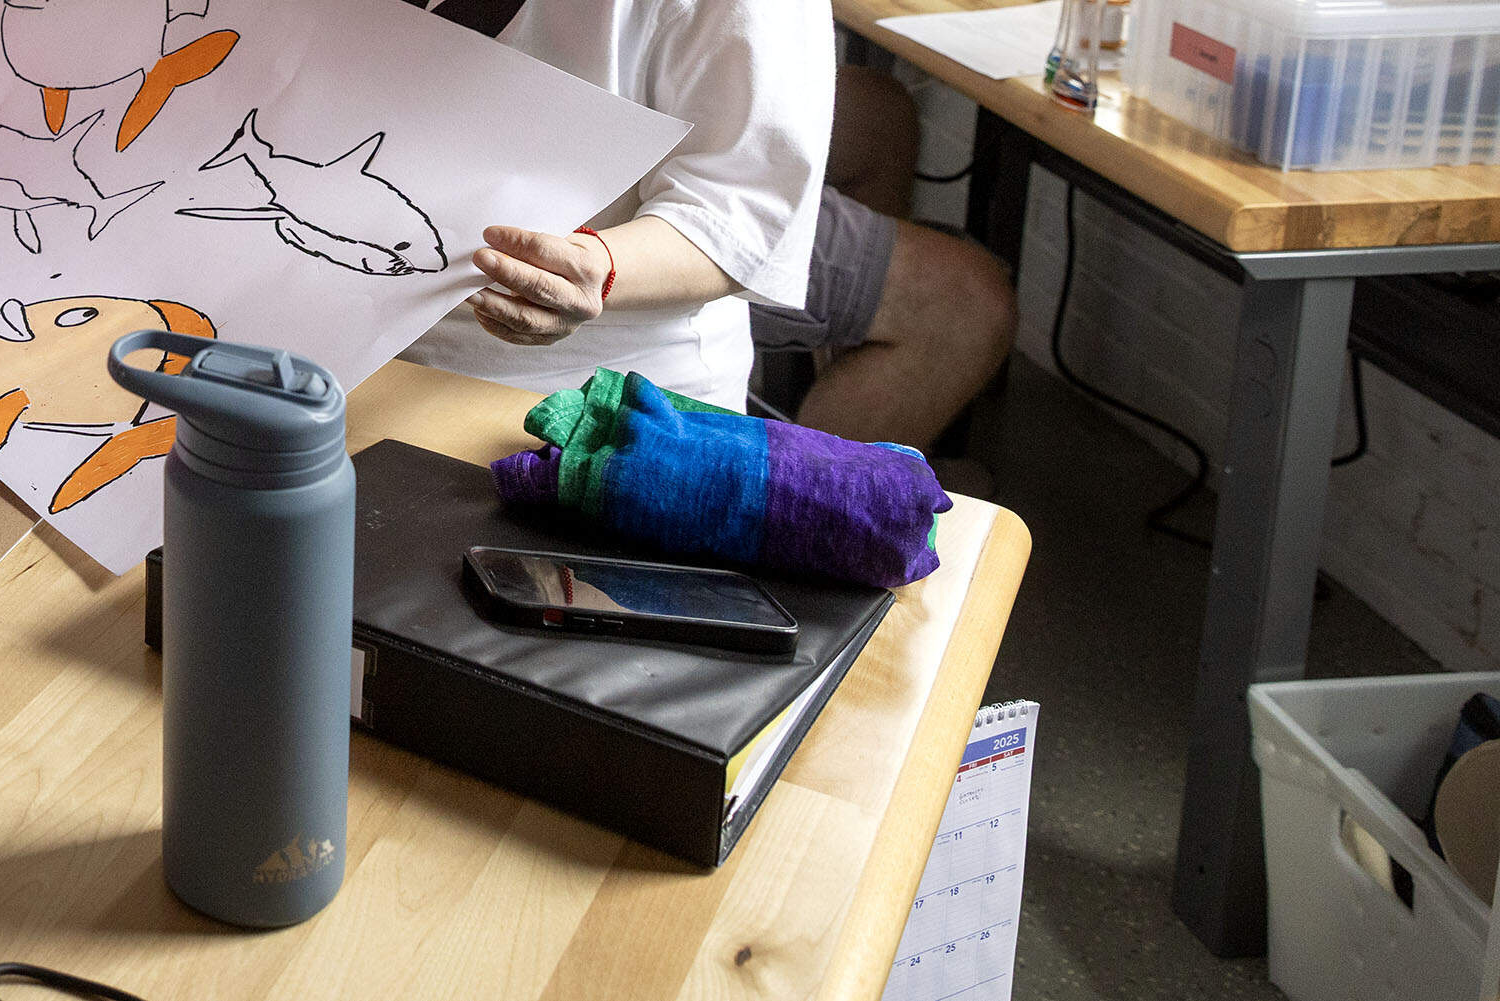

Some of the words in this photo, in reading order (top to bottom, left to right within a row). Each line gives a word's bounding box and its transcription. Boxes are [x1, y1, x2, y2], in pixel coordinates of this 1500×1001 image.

[993, 733, 1020, 750] 2025
[991, 763, 997, 771] 5
[954, 831, 963, 840] 11
[989, 819, 999, 829] 12
[914, 900, 924, 909] 17
[950, 887, 959, 896] 18
[985, 875, 995, 884] 19
[910, 956, 921, 967] 24
[945, 943, 956, 953] 25
[980, 930, 990, 940] 26
